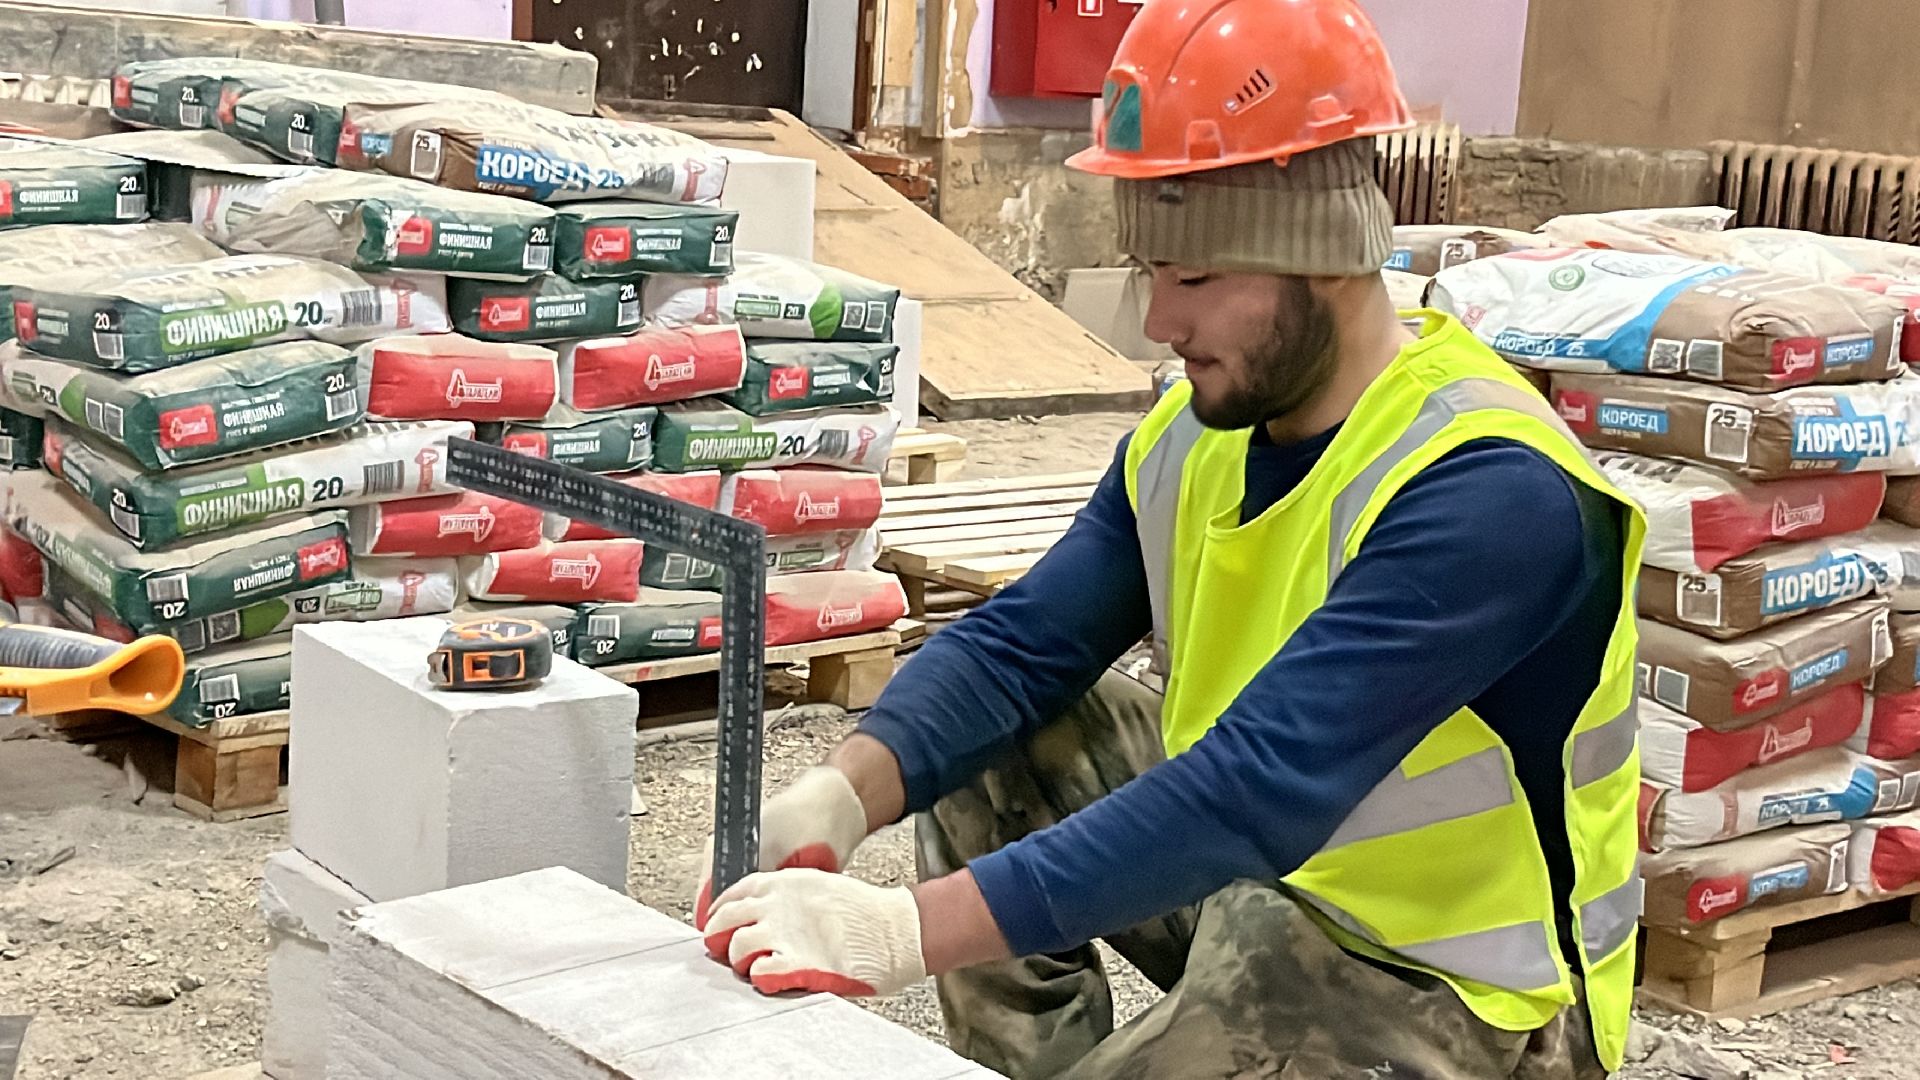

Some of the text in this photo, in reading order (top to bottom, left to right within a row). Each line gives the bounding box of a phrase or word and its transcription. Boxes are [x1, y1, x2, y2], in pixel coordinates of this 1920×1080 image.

[182, 86, 195, 101] 20
[291, 114, 305, 129] 20
[416, 134, 430, 151] 25
[482, 150, 625, 192] КОРОЕД 25
[120, 176, 137, 192] 20
[439, 233, 493, 250] ФИНИШНАЯ
[530, 227, 546, 243] 20
[715, 226, 729, 241] 20
[620, 284, 634, 300] 20
[786, 306, 799, 317] 20
[94, 312, 110, 330] 20
[166, 304, 284, 346] ФИНИШНАЯ
[294, 301, 323, 326] 20
[326, 373, 345, 392] 20
[223, 402, 285, 427] ФИНИШНАЯ
[1601, 408, 1659, 433] КОРОЕД
[1712, 408, 1737, 427] 25
[633, 421, 648, 438] 20
[1796, 420, 1887, 457] КОРОЕД
[689, 435, 804, 460] ФИНИШНАЯ 20
[184, 482, 301, 526] ФИНИШНАЯ
[313, 476, 343, 502] 20
[234, 565, 296, 591] ФИНИШНАЯ
[1683, 574, 1707, 592] 25
[1766, 561, 1860, 609] КОРОЕД
[162, 601, 187, 619] 20
[553, 629, 567, 644] 20
[597, 639, 616, 654] 20
[215, 702, 236, 718] 20
